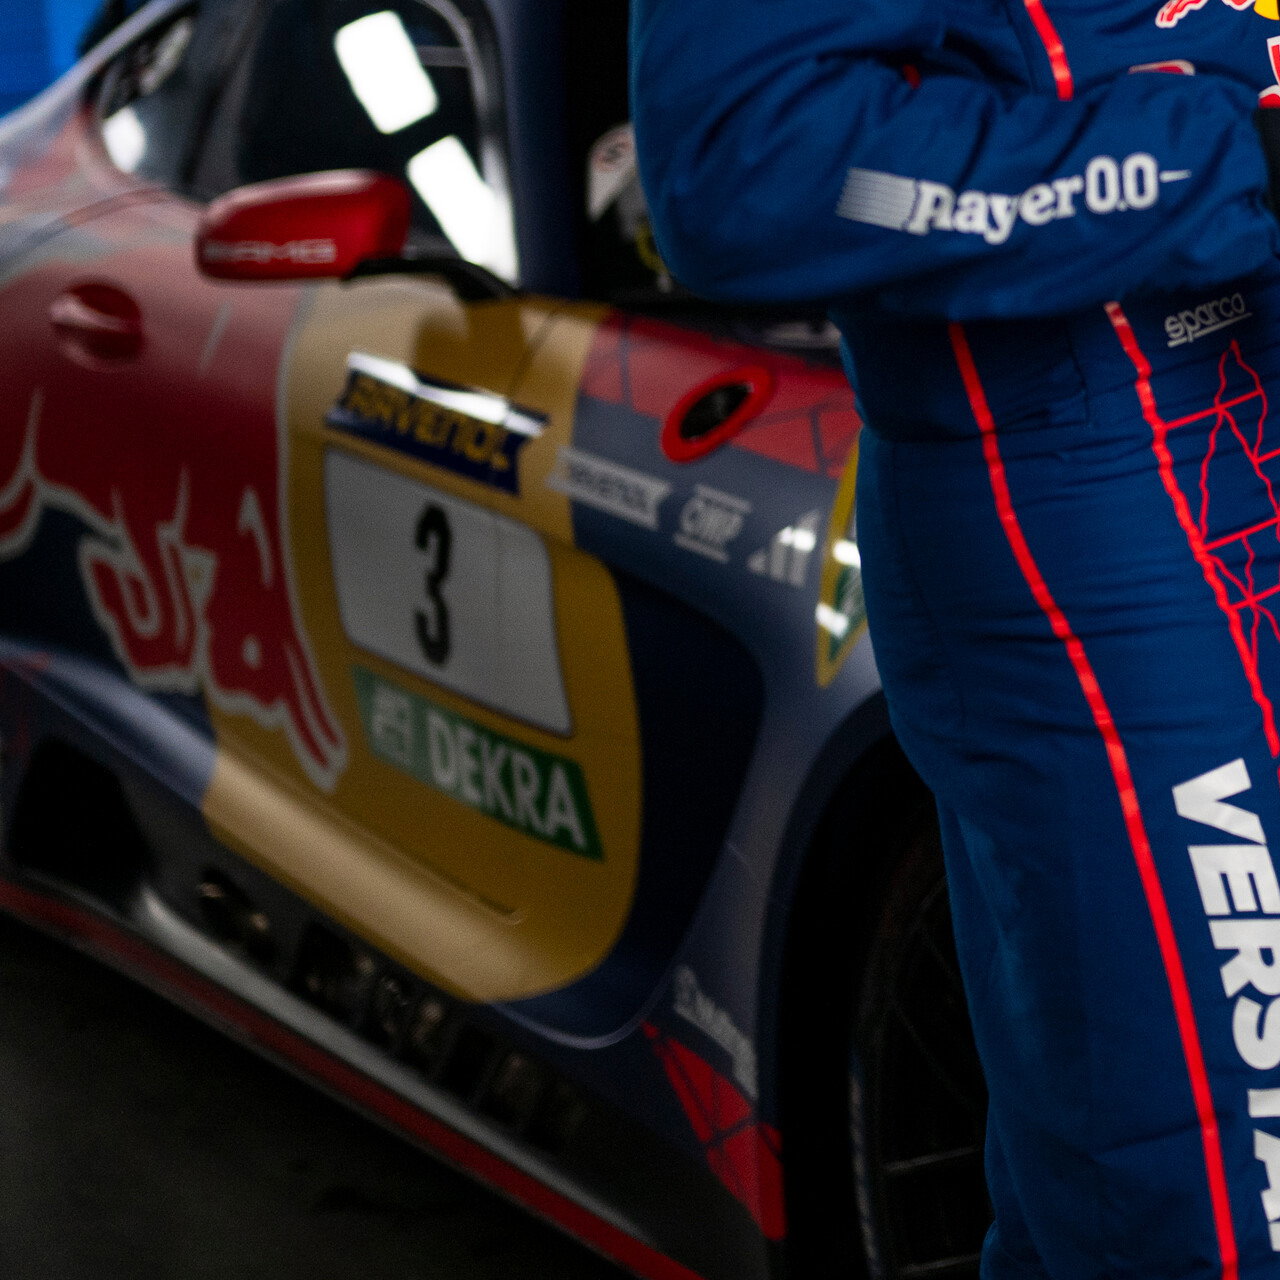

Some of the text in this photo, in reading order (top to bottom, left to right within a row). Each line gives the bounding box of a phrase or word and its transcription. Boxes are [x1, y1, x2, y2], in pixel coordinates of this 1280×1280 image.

[1164, 293, 1246, 347] sparco
[411, 502, 453, 667] 3
[427, 710, 588, 849] DEKRA
